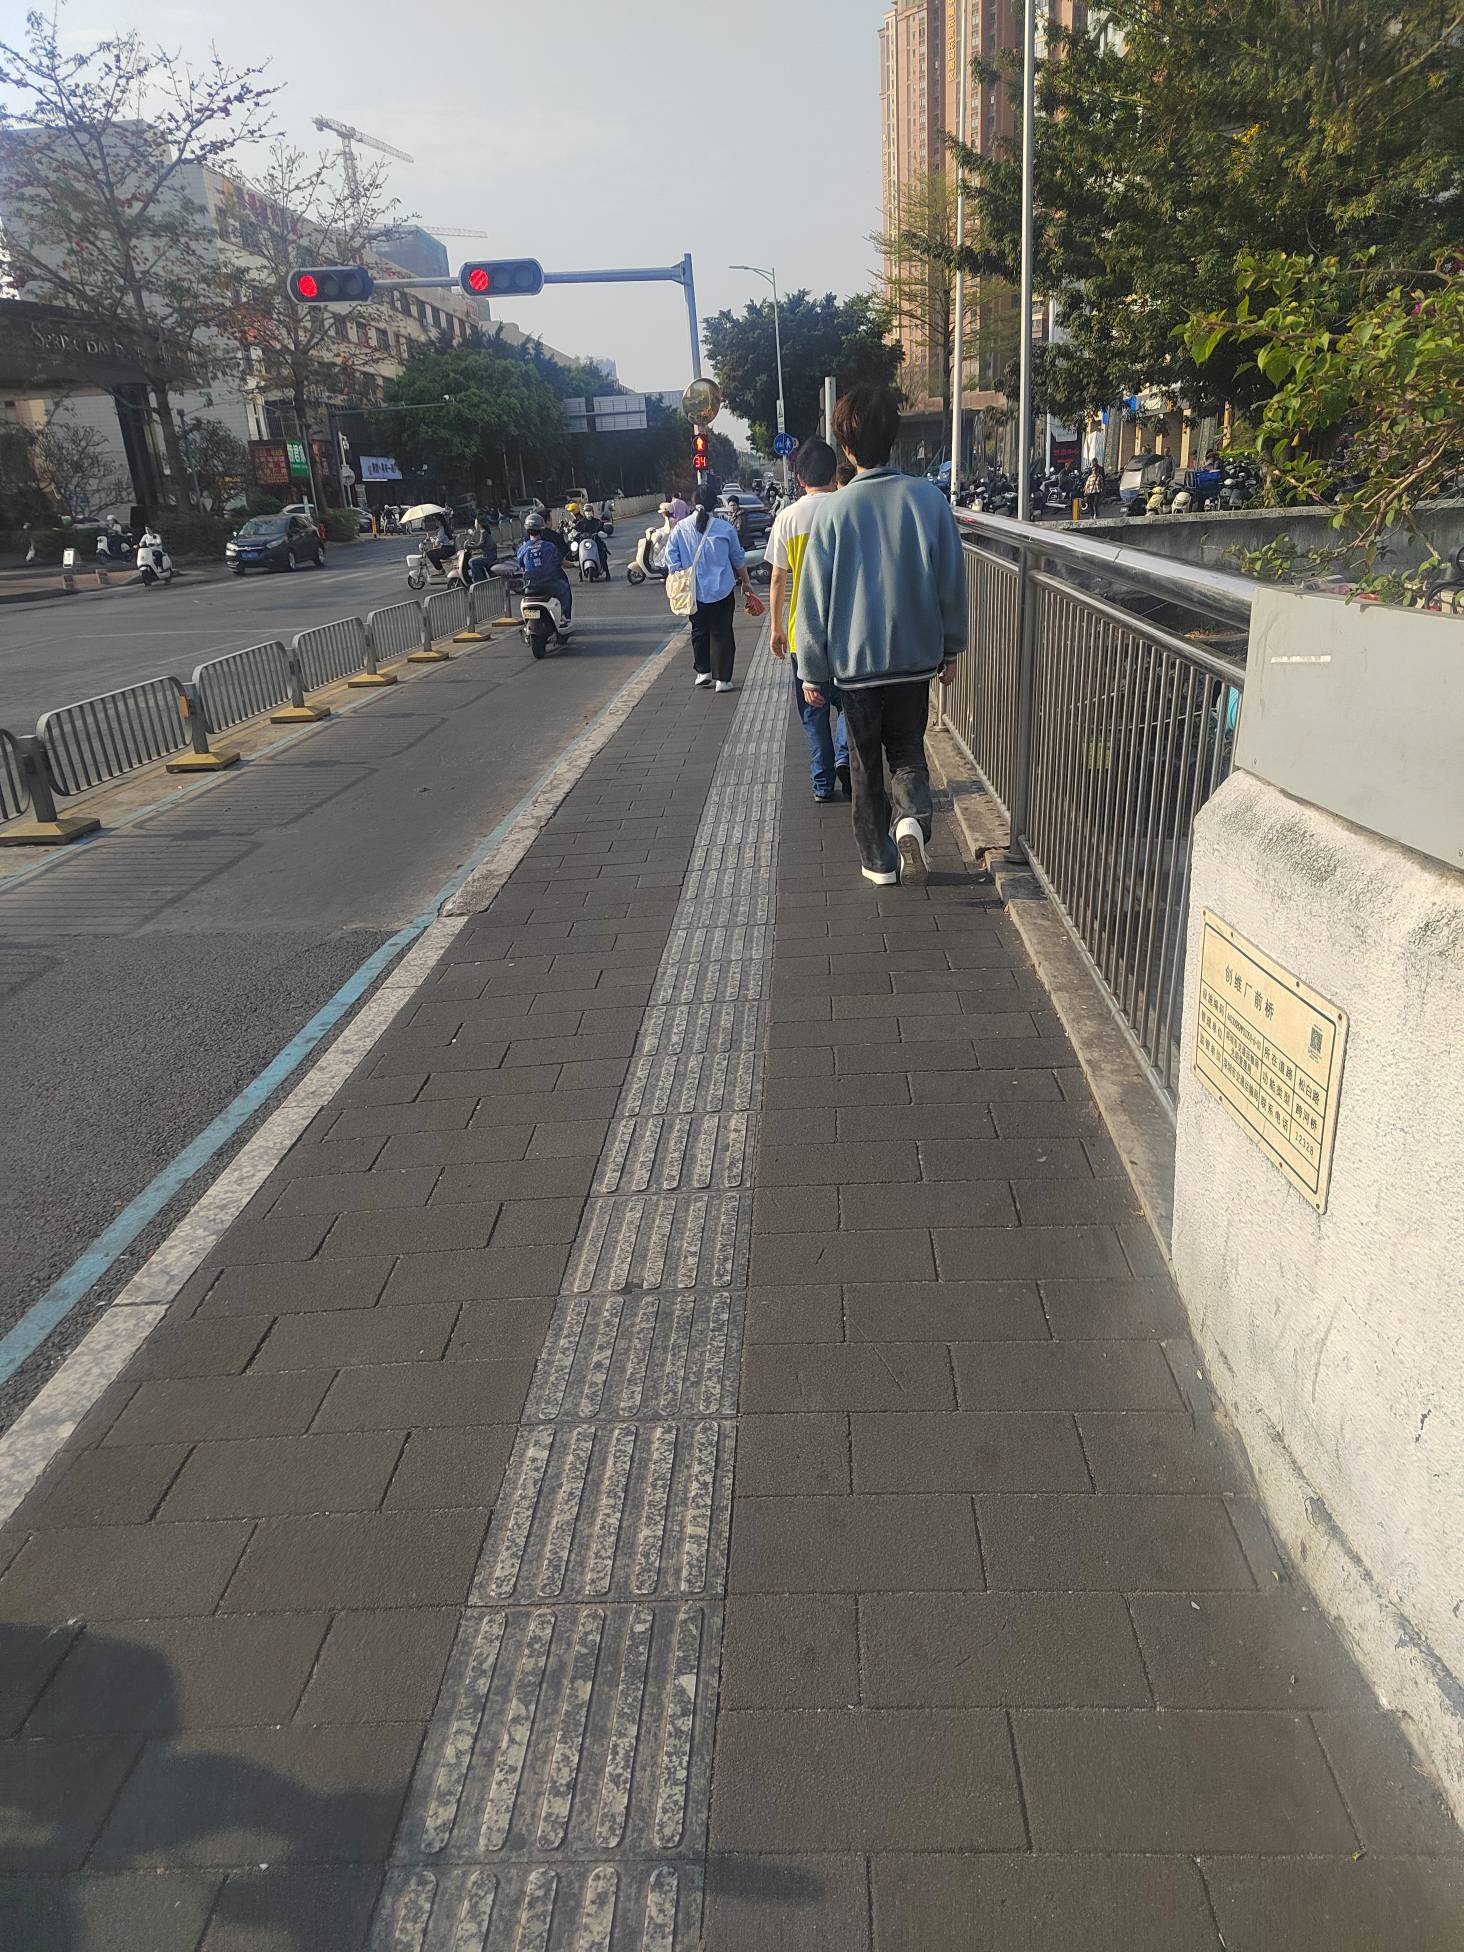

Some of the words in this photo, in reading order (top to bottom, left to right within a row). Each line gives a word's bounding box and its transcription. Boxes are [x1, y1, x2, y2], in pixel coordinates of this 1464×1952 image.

[694, 457, 706, 468] 34
[1225, 965, 1275, 1021] 创维厂前桥
[1201, 1010, 1223, 1041] 管理单位
[1263, 1045, 1294, 1082] 所在道路
[1262, 1070, 1291, 1107] 功能类型
[1298, 1077, 1320, 1107] 松白路
[1260, 1094, 1289, 1133] 联系电话
[1295, 1102, 1318, 1133] 跨河桥
[1294, 1131, 1314, 1156] 12328
